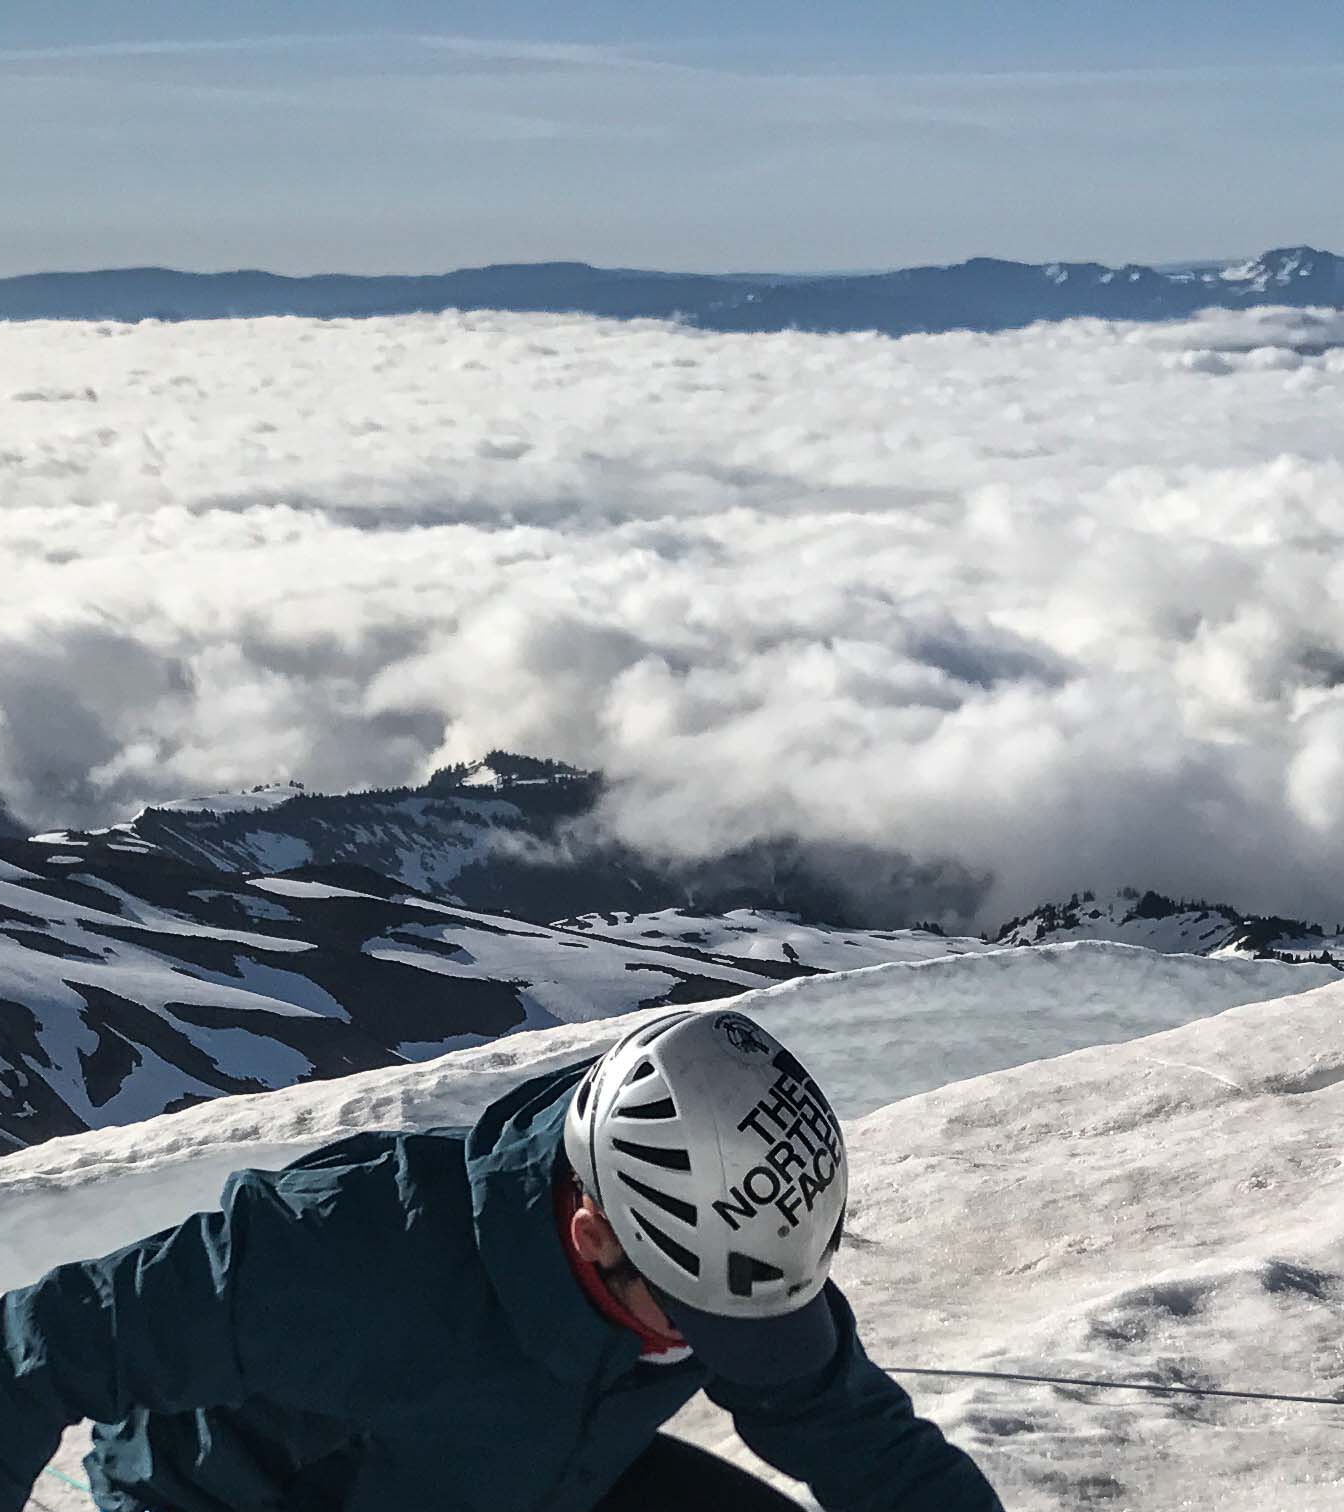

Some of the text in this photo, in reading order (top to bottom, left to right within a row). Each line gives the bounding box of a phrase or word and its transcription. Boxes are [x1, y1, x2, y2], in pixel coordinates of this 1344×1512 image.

[737, 1073, 806, 1146] THE
[712, 1094, 833, 1231] NORTH
[775, 1136, 842, 1228] FACE
